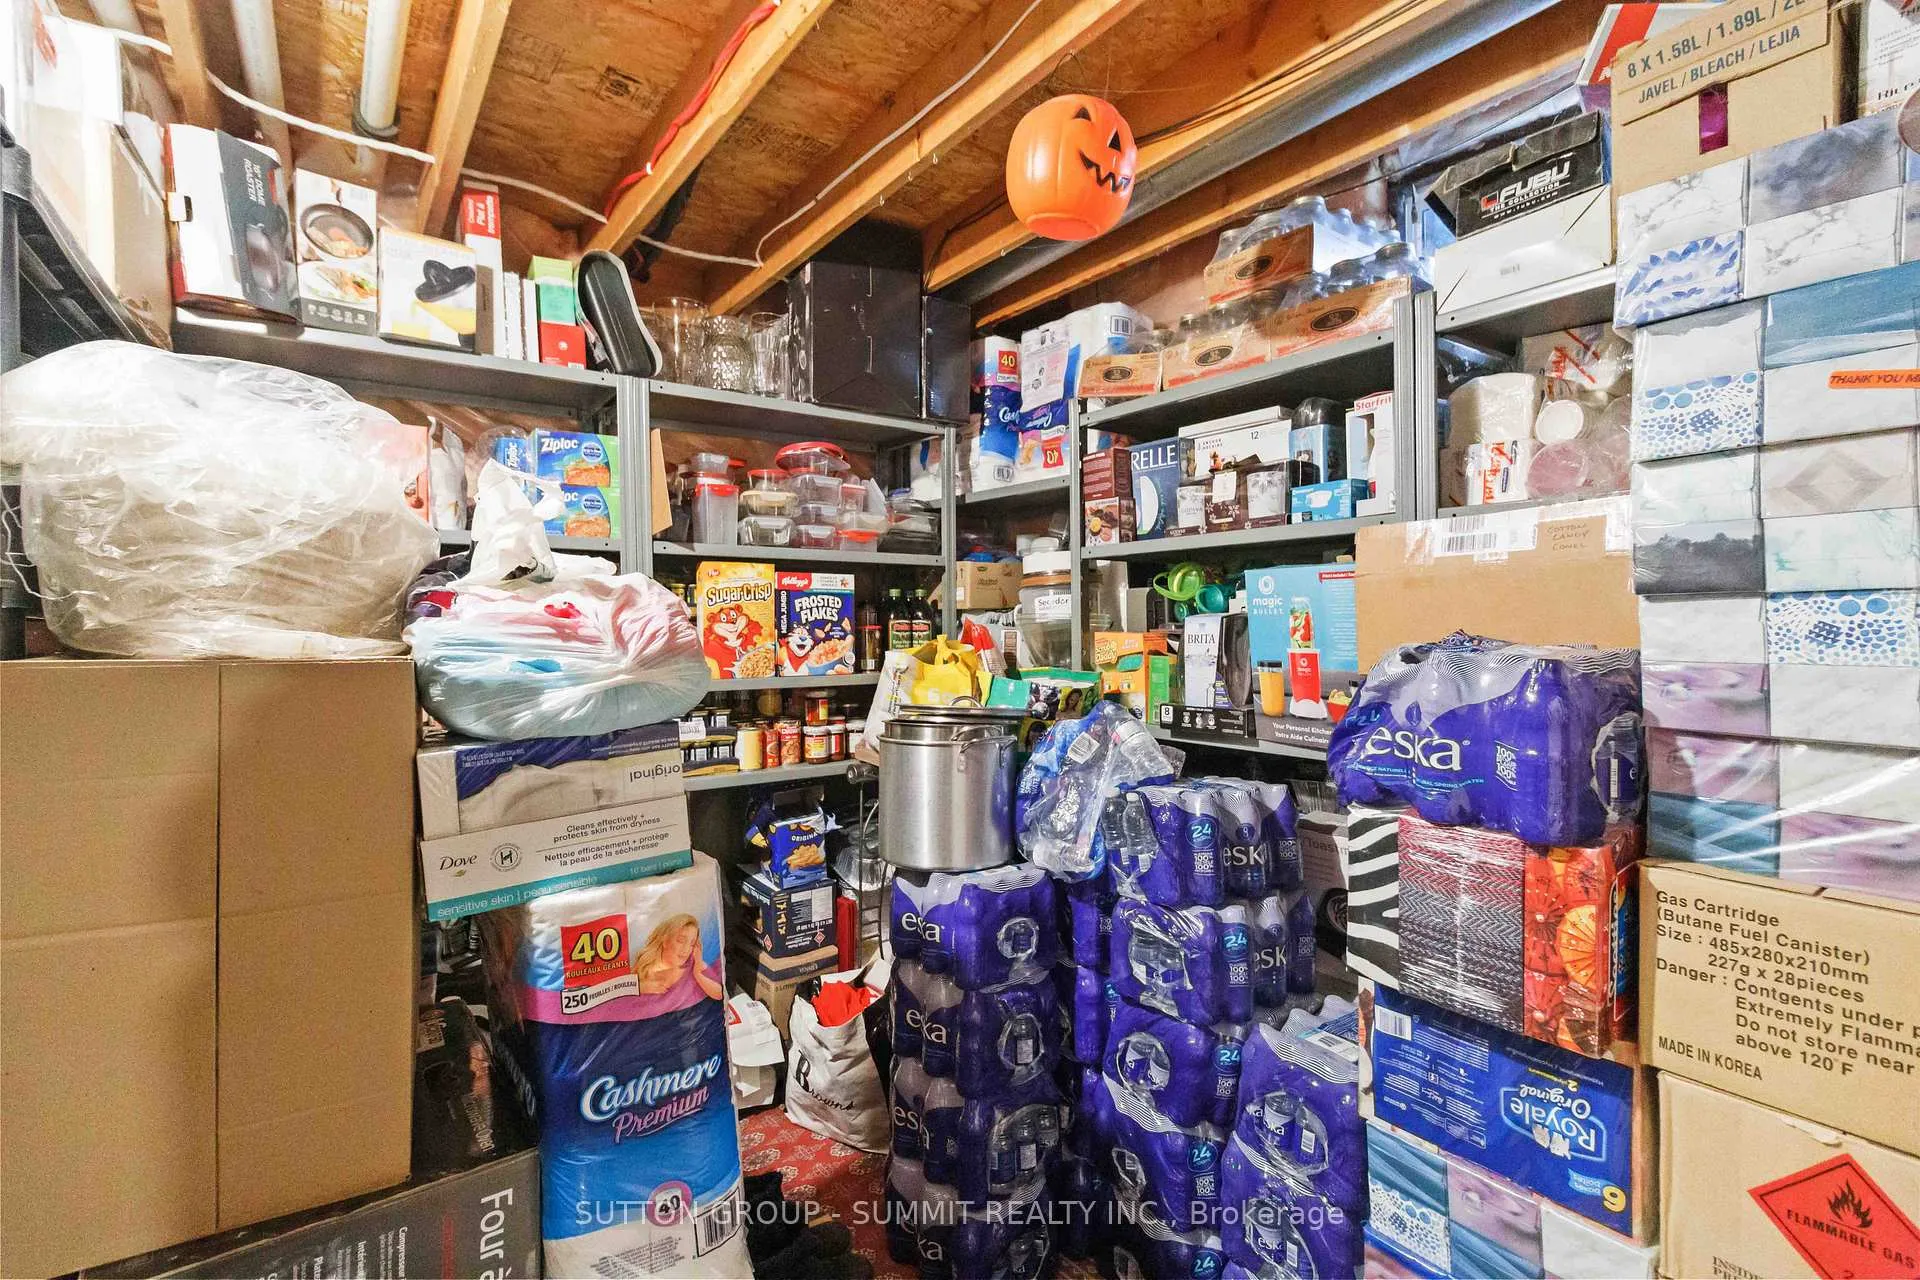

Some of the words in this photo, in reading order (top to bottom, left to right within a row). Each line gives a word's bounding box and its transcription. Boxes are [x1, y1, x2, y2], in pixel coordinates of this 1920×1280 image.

[1627, 62, 1637, 79] 8
[1641, 56, 1651, 72] X
[1656, 36, 1701, 65] 1.58L
[1717, 7, 1766, 39] 1.89L
[1638, 77, 1678, 104] JAVEL
[1690, 48, 1745, 81] BLEACH
[1759, 25, 1800, 53] LEJIA
[243, 158, 257, 201] ROASTER
[1500, 161, 1570, 203] FUBU
[1490, 202, 1505, 212] THE
[1509, 181, 1560, 205] COLLECTION
[1001, 355, 1015, 367] 40
[541, 438, 578, 453] Ziploc
[1251, 431, 1259, 440] 12
[1131, 445, 1178, 471] RELLE
[781, 574, 809, 588] Kellogg's
[794, 595, 842, 612] FROSTED
[801, 607, 839, 623] FLAKES
[1253, 597, 1282, 609] magic
[1187, 633, 1216, 644] BRITA
[1164, 707, 1170, 716] 8
[1272, 722, 1284, 731] Your
[1286, 724, 1311, 734] Personal
[1365, 727, 1462, 771] eska
[629, 764, 681, 783] original
[553, 831, 589, 843] protects
[590, 827, 608, 836] skin
[609, 823, 628, 833] from
[629, 817, 661, 829] dryness
[566, 822, 595, 832] Cleans
[597, 815, 638, 827] effectively
[1191, 824, 1212, 837] 24
[440, 854, 479, 871] Dove
[545, 850, 576, 862] Nettoie
[577, 839, 630, 855] efficacement
[560, 859, 568, 867] la
[570, 855, 591, 867] peau
[592, 852, 603, 860] de
[437, 898, 488, 918] sensitive
[490, 892, 514, 905] skin
[1656, 890, 1688, 908] Gas
[1694, 898, 1780, 927] Cartridge
[571, 927, 621, 963] 40
[1224, 934, 1247, 948] 24
[1657, 906, 1723, 933] (Butane
[1729, 923, 1768, 943] Fuel
[1776, 933, 1870, 966] Canister)
[1656, 924, 1692, 943] Size
[1709, 937, 1869, 985] 485x280x210mm
[566, 966, 601, 978] ROULEAUX
[1708, 954, 1750, 977] 227g
[1757, 967, 1767, 979] x
[1774, 969, 1865, 1003] 28pieces
[564, 993, 588, 1008] 250
[614, 982, 637, 990] ROULEAU
[1656, 958, 1716, 984] Danger
[1734, 978, 1834, 1015] Contgents
[1842, 1008, 1904, 1032] under
[1736, 995, 1833, 1034] Extremely
[1841, 1024, 1920, 1058] Flamma
[1220, 1050, 1241, 1061] 24
[1736, 1014, 1760, 1031] Do
[1767, 1025, 1798, 1043] not
[1805, 1035, 1858, 1059] store
[1866, 1053, 1915, 1075] near
[1736, 1034, 1792, 1059] above
[1659, 1036, 1694, 1058] MADE
[1698, 1048, 1710, 1064] IN
[1715, 1053, 1763, 1080] KOREA
[580, 1053, 723, 1122] Cashmere
[612, 1085, 709, 1142] Premium
[1520, 1084, 1591, 1120] Original
[1510, 1097, 1596, 1151] Royale
[1192, 1148, 1211, 1162] 24
[659, 1194, 681, 1215] 40
[480, 1188, 513, 1260] Four
[1786, 1209, 1876, 1252] FLAMMABLE
[1883, 1248, 1915, 1269] GAS
[1194, 1256, 1214, 1269] 24
